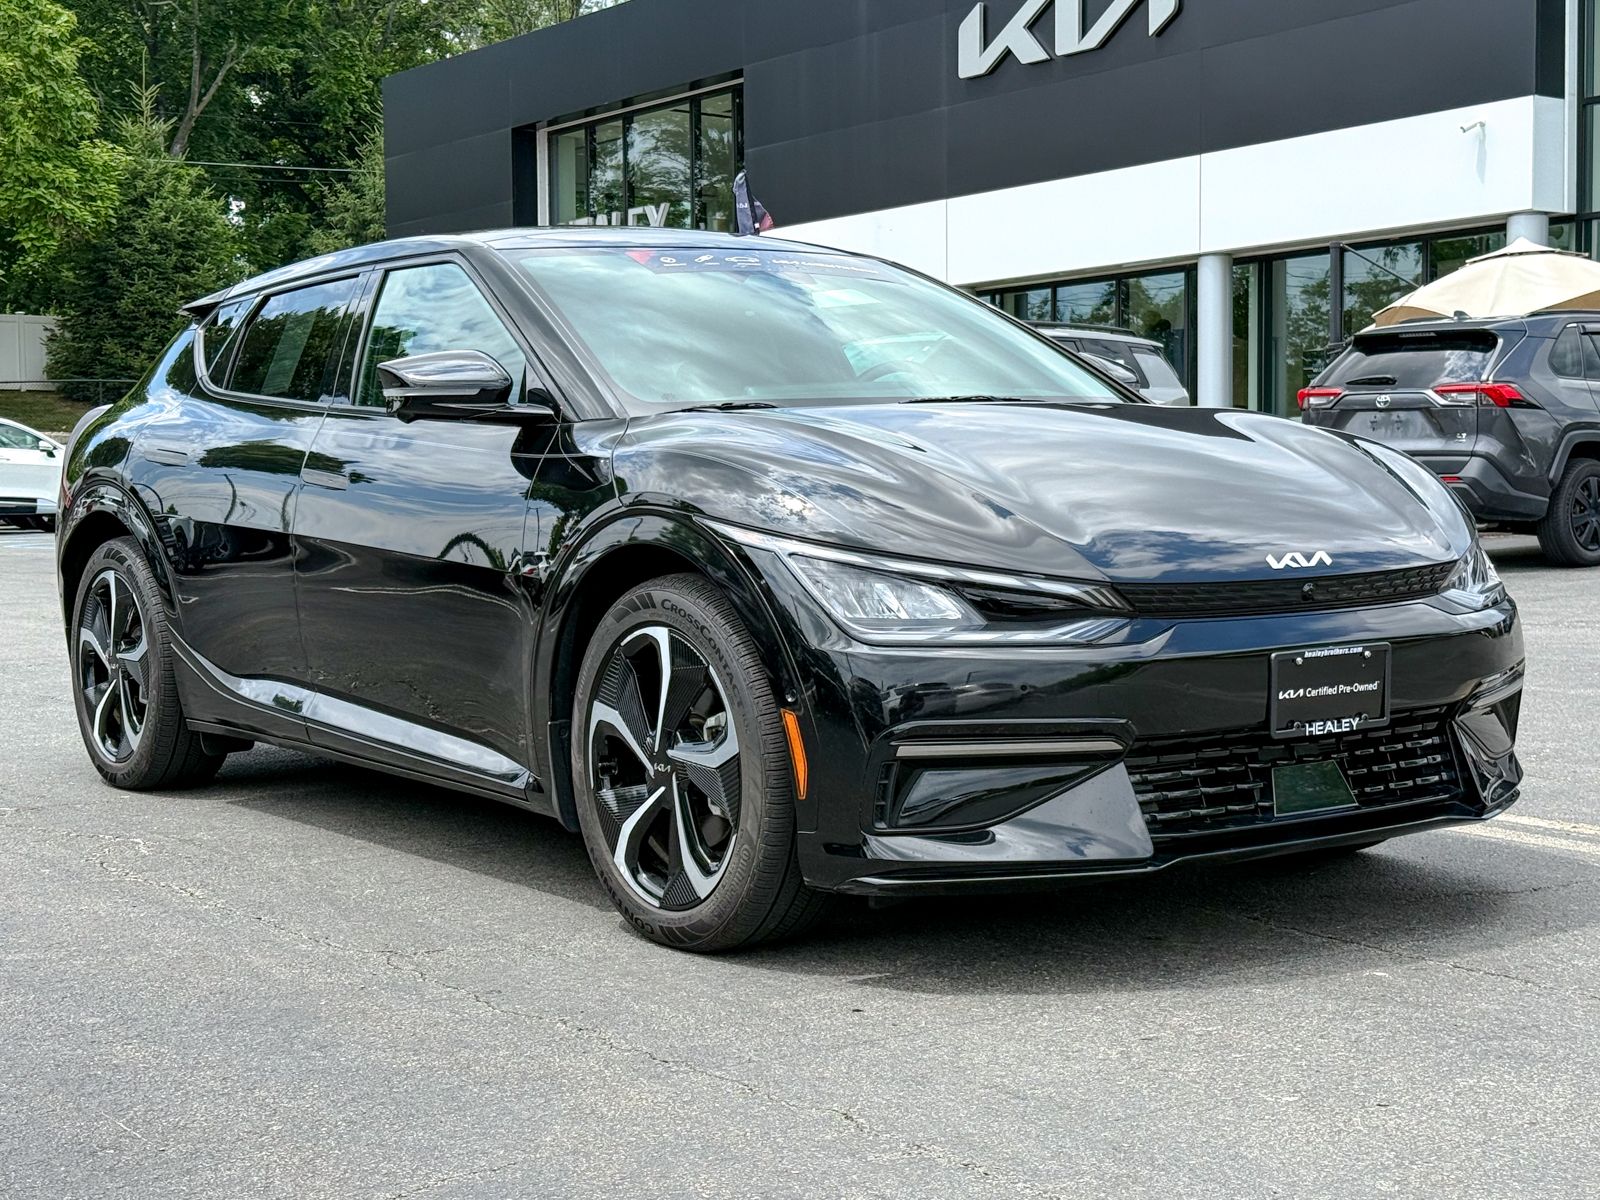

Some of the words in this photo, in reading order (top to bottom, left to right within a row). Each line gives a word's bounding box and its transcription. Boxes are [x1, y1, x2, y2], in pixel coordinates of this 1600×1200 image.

[1265, 550, 1333, 570] KIA
[1304, 646, 1363, 658] healeybrothers.com
[1278, 688, 1304, 700] KIA
[1305, 685, 1338, 697] Certified
[1338, 681, 1378, 694] Pre-Owned
[1305, 717, 1360, 736] HEALEY
